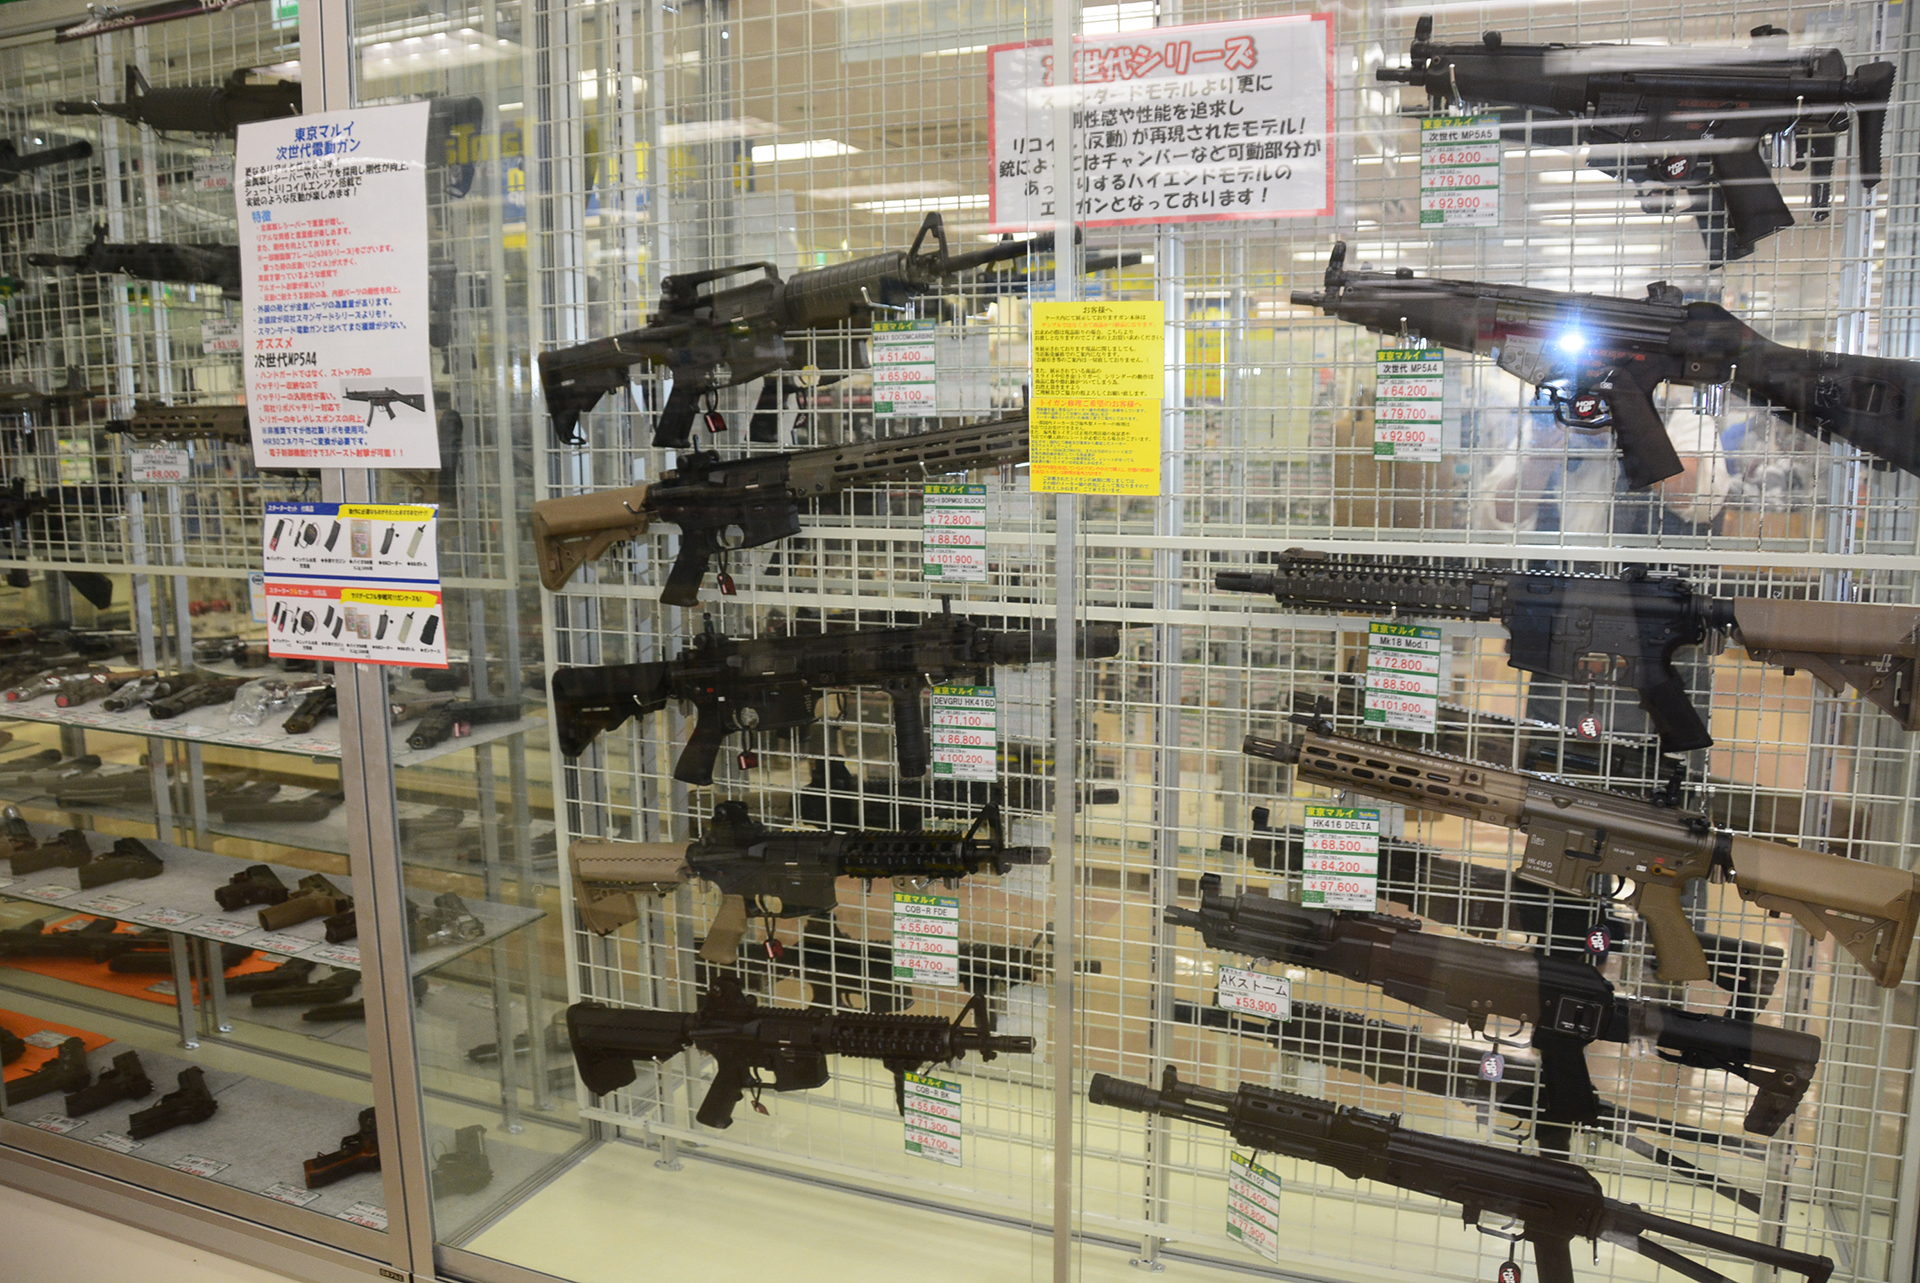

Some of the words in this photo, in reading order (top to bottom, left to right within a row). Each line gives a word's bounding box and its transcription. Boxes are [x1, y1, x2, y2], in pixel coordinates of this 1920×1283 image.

[1041, 74, 1273, 109] スンダードモデルより更に
[1423, 118, 1472, 130] 東京マルイ
[294, 121, 354, 142] 東京マルイ
[1014, 117, 1306, 154] リコイ(反動)が再現されたモデル!
[1429, 132, 1458, 141] 次世代
[1462, 130, 1492, 140] MP5A5
[276, 140, 360, 160] 次世代電動ガン
[1000, 139, 1322, 179] 銃によはチャンバーなど可動部分が
[1430, 152, 1481, 164] ¥64,200
[1668, 160, 1686, 172] HOP
[1672, 166, 1684, 175] UP
[1024, 164, 1292, 197] あっりするハイエンドモデルの
[1429, 174, 1480, 186] ¥79,700
[1040, 187, 1268, 217] エガンとなっております！
[1429, 197, 1480, 209] ¥92,900
[252, 210, 272, 224] 特徴
[1083, 306, 1113, 314] お客様へ
[874, 322, 912, 332] 東京マルイ
[256, 337, 292, 350] オススメ
[254, 352, 317, 368] 次世代MP5A4
[880, 351, 920, 362] ¥51,400
[1378, 351, 1420, 361] 東京マルイ
[1383, 364, 1408, 373] 次世代
[1411, 364, 1438, 372] MP5A4
[880, 371, 921, 382] ¥65,900
[880, 390, 921, 401] ¥78,100
[1383, 385, 1428, 396] ¥64,200
[1575, 400, 1596, 408] HOP
[1382, 408, 1426, 420] ¥79,700
[1381, 430, 1426, 442] ¥92,900
[925, 485, 964, 494] 東京マルイ
[930, 515, 971, 526] ¥72,800
[930, 534, 971, 544] ¥88,500
[930, 554, 972, 564] ¥101,900
[1370, 623, 1416, 636] 東京マルイ
[1380, 636, 1402, 646] Mk18
[1405, 639, 1428, 650] Mod.1
[1375, 656, 1422, 670] ¥72,800
[934, 686, 974, 696] 東京マルイ
[1374, 678, 1421, 692] ¥88,500
[934, 697, 962, 705] DEVGRU
[965, 698, 994, 707] HK416D
[1372, 700, 1421, 713] ¥101,900
[940, 715, 982, 726] ¥71,100
[1582, 722, 1590, 734] UP
[1587, 718, 1596, 738] HOP
[940, 734, 982, 745] ¥86,800
[940, 754, 982, 764] ¥100,200
[1306, 807, 1354, 818] 東京マルイ
[1313, 820, 1342, 828] HK416
[1345, 822, 1372, 830] DELTA
[1312, 840, 1361, 852] ¥68,500
[1312, 860, 1360, 872] ¥84,200
[1310, 881, 1360, 893] ¥97,600
[895, 894, 936, 904] 東京マルイ
[905, 905, 932, 914] CQB-R
[934, 908, 948, 916] FDE
[900, 922, 944, 934] ¥55,600
[900, 941, 943, 952] ¥71,300
[1590, 936, 1599, 949] UP
[1595, 932, 1604, 951] HOP
[900, 958, 942, 970] ¥84,700
[1220, 974, 1287, 996] AKストーム
[1236, 997, 1276, 1014] ¥53,900
[1485, 1062, 1492, 1074] UP
[1489, 1058, 1498, 1077] HOP
[916, 1086, 938, 1096] CQB-R
[941, 1091, 950, 1099] BK
[910, 1102, 948, 1116] ¥55,600
[910, 1118, 948, 1133] ¥71,300
[910, 1134, 948, 1150] ¥84,700
